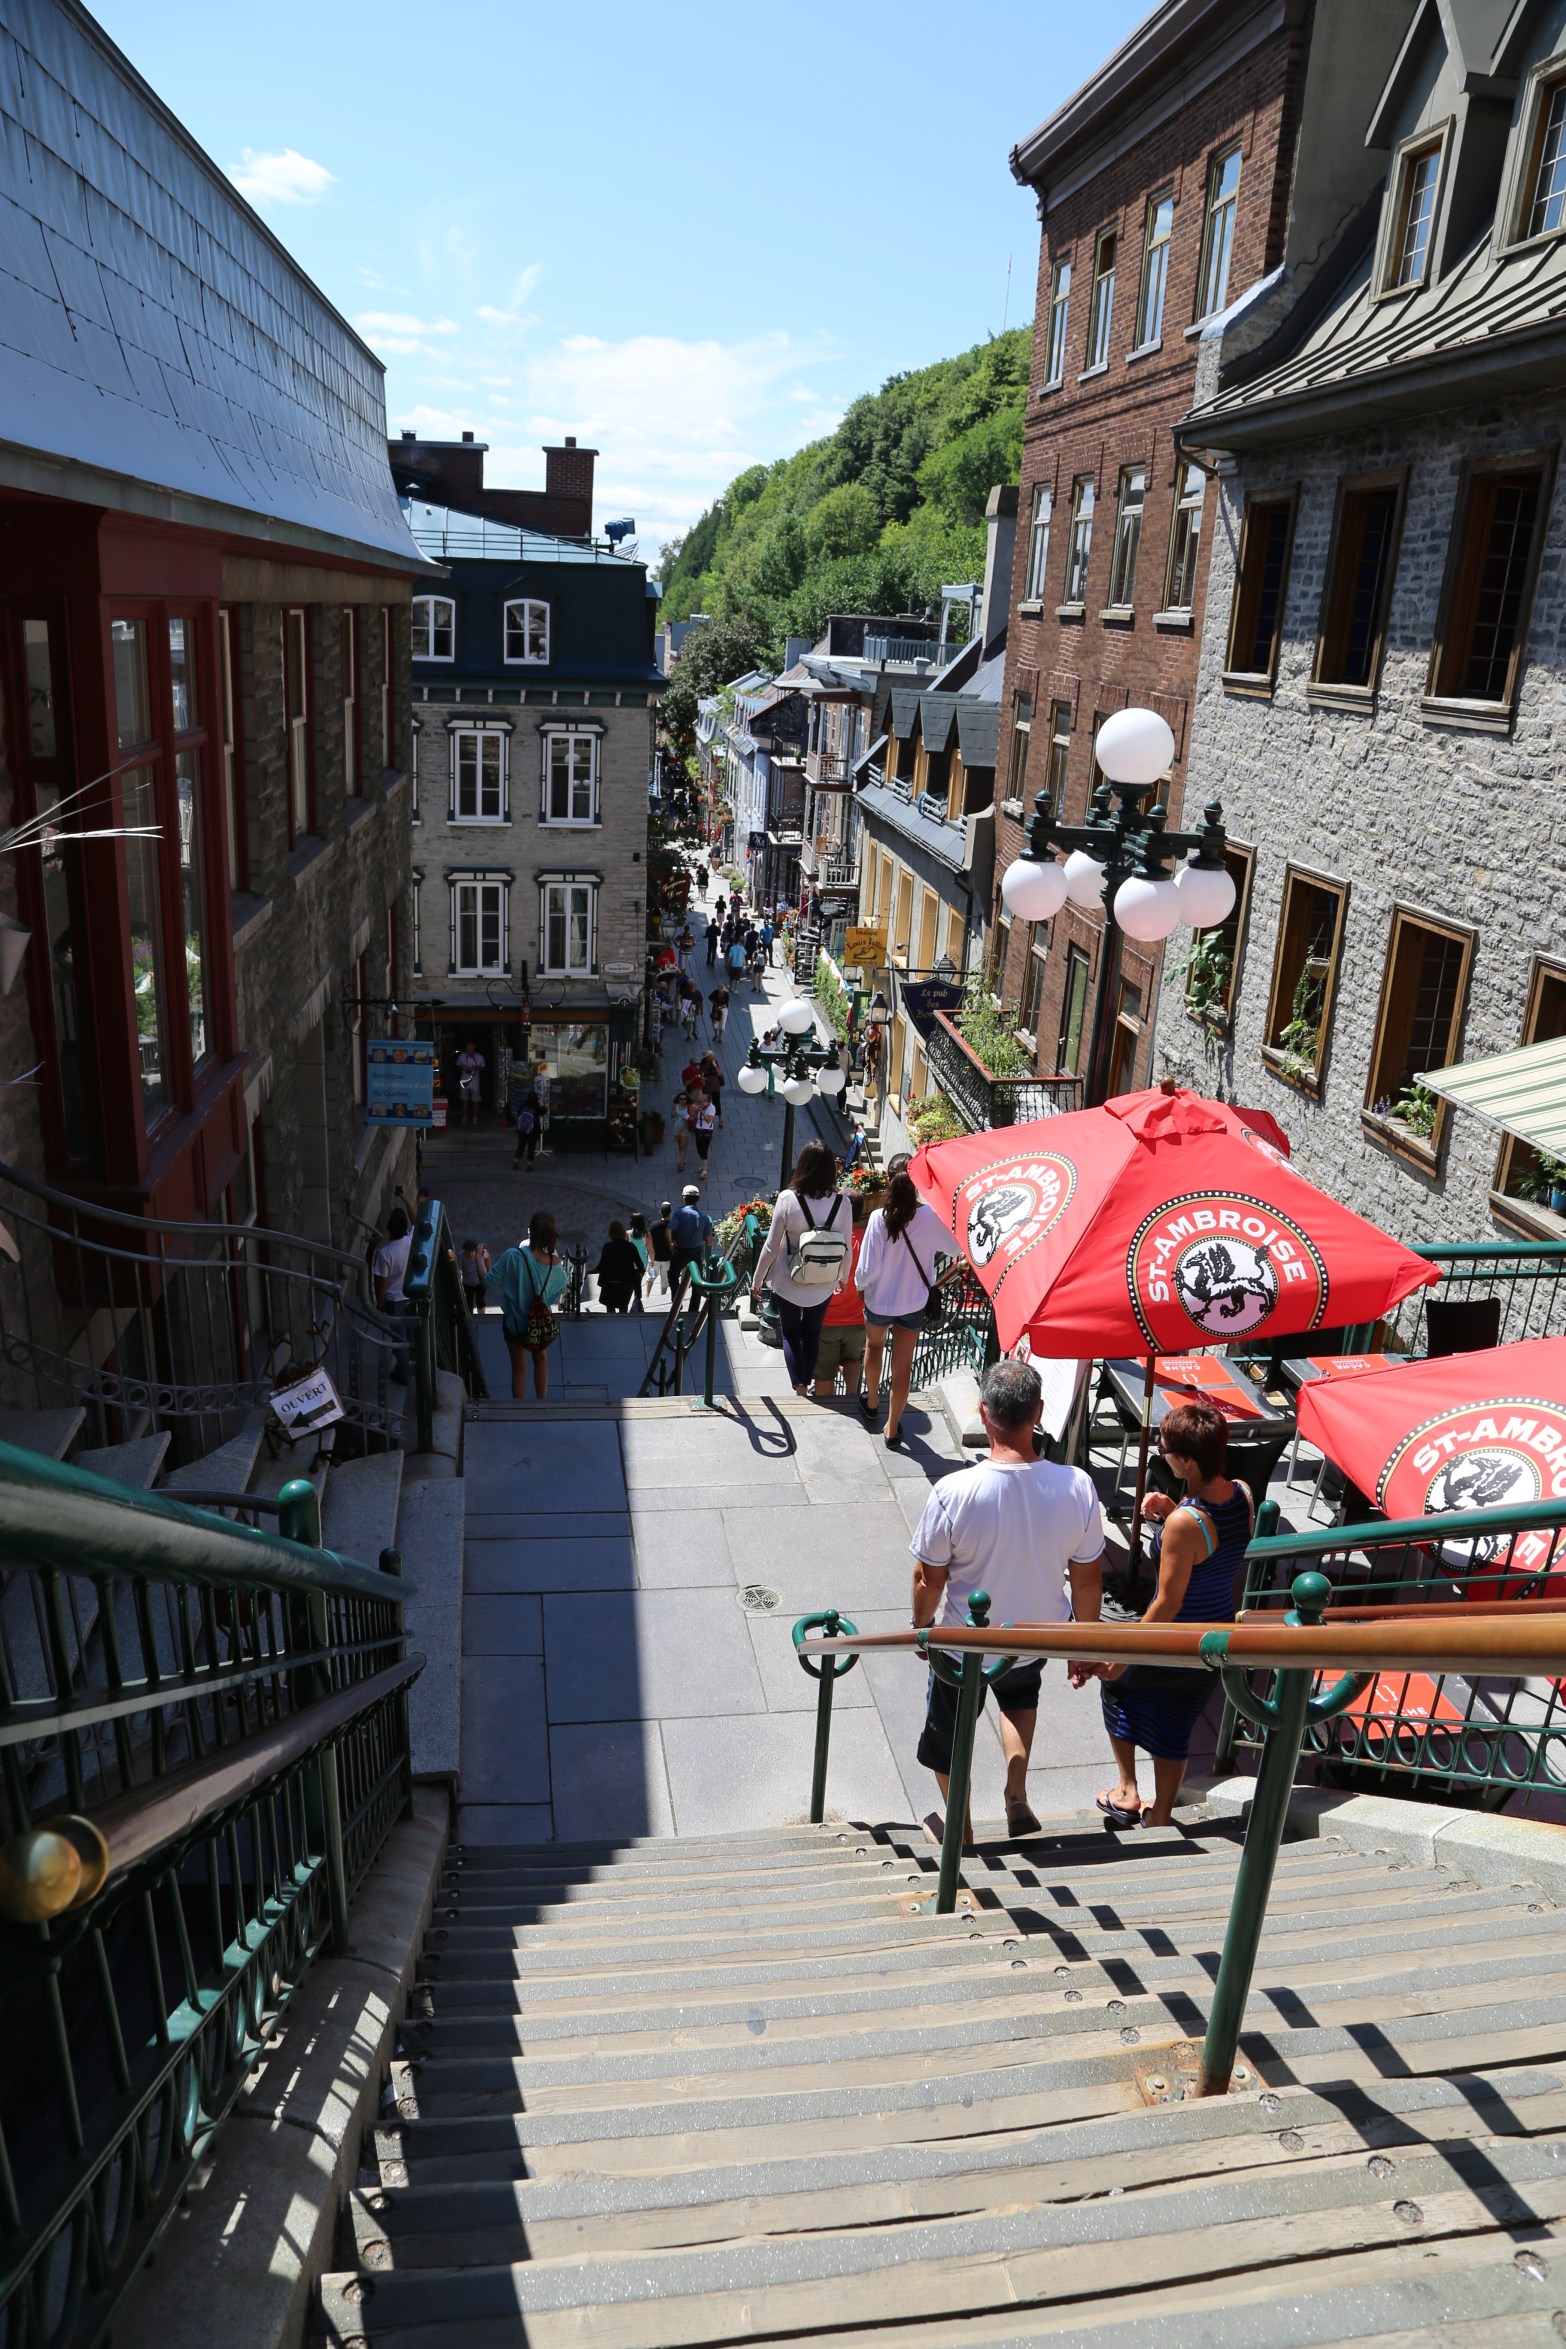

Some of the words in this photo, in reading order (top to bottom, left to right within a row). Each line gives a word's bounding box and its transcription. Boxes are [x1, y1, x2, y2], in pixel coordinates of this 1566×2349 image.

[846, 939, 867, 951] Louis
[920, 988, 931, 997] Le
[933, 988, 948, 998] pub
[372, 1072, 404, 1080] Boutique
[965, 1164, 1060, 1257] ST-AMBROISE
[1148, 1209, 1307, 1303] ST-AMBROISE
[281, 1382, 327, 1413] OUVERT
